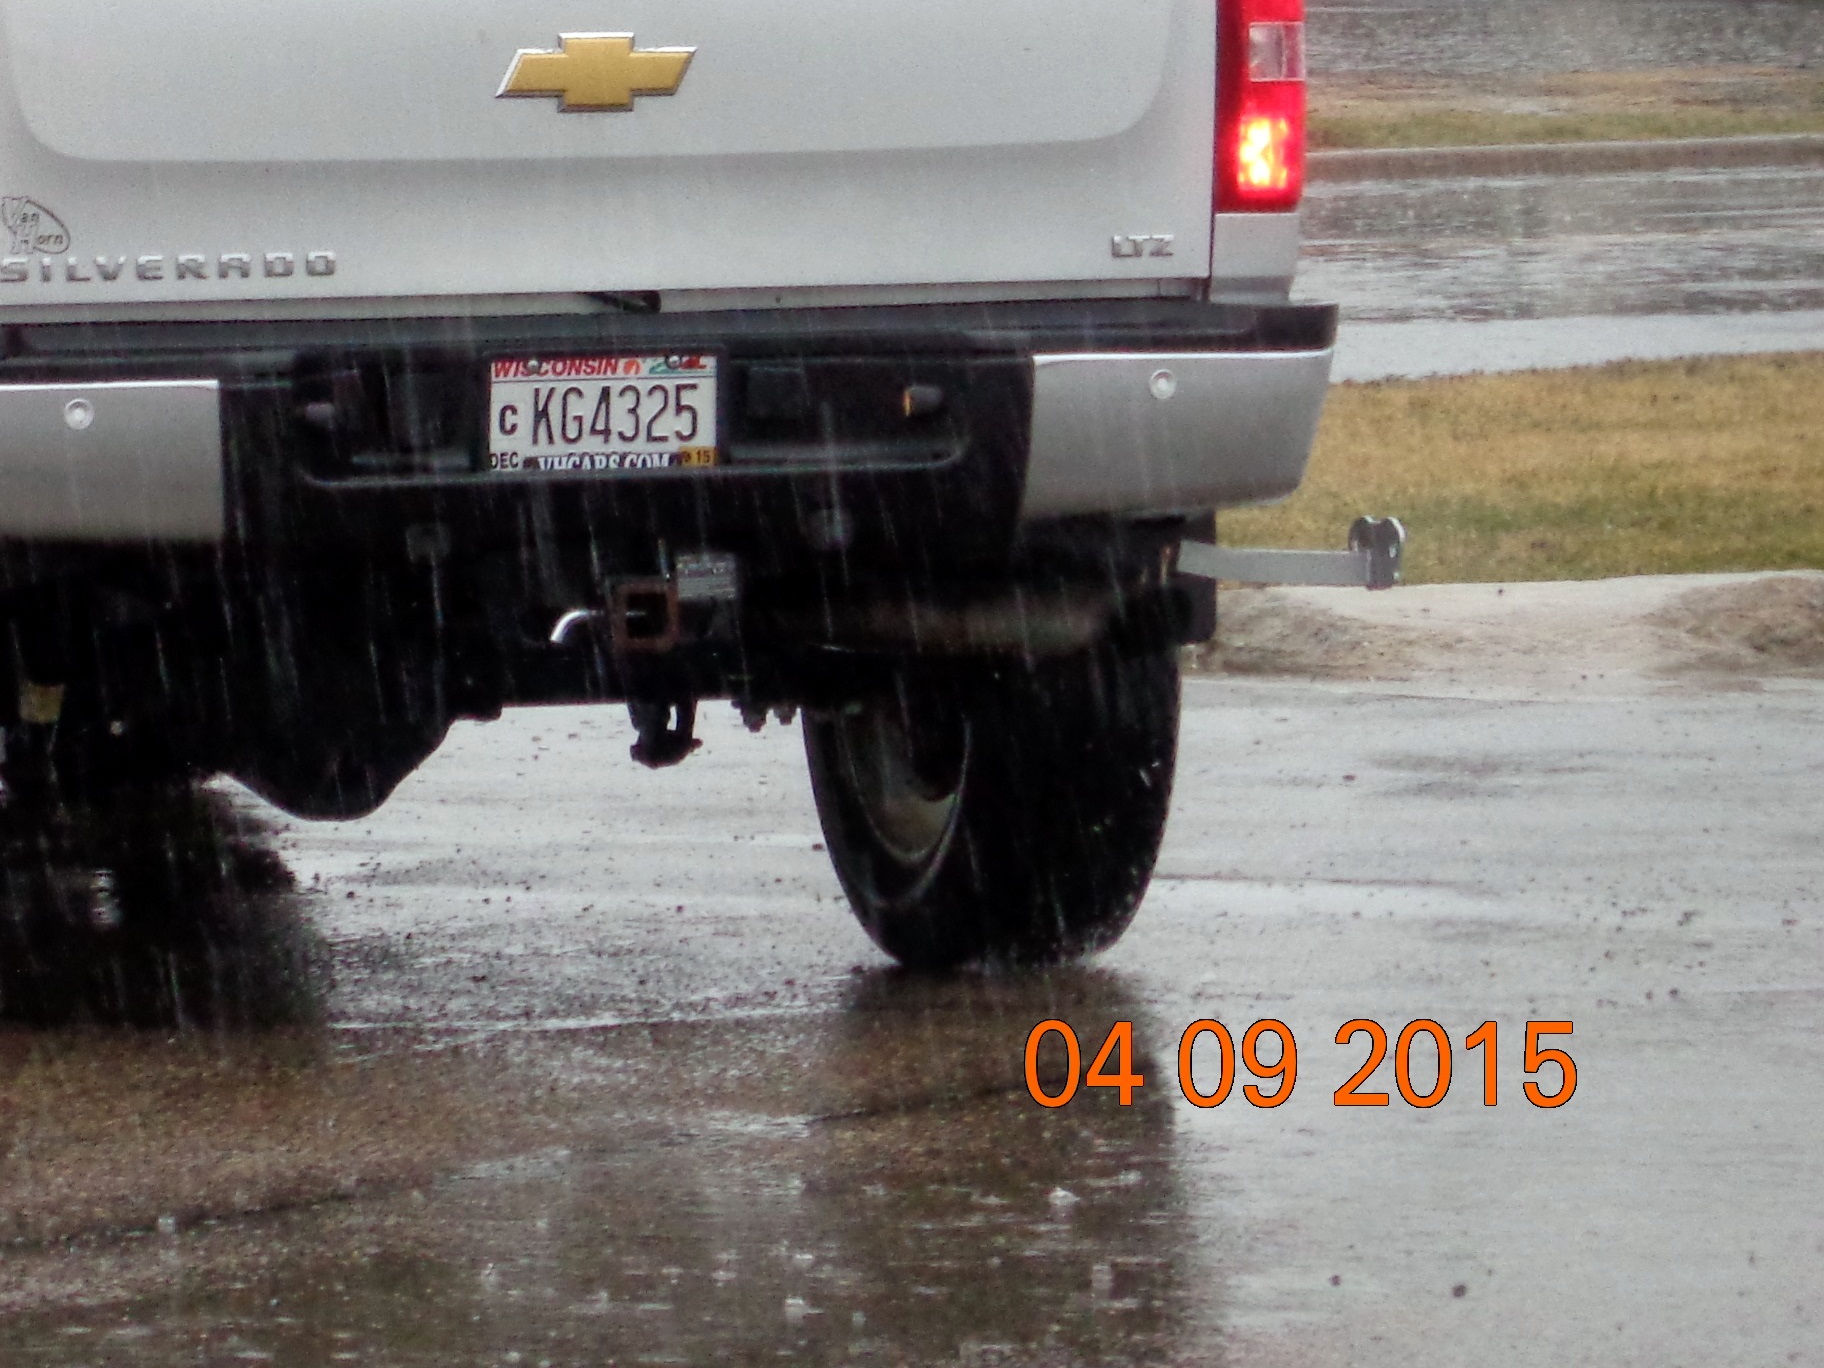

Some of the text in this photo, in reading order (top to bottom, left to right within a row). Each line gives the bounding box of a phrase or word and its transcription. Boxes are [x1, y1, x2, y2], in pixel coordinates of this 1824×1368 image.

[1111, 233, 1176, 258] LTZ
[494, 356, 619, 379] WISCONSIN
[498, 383, 699, 446] C KG4325
[491, 451, 519, 470] DEC
[537, 451, 671, 471] VHCARSCOM
